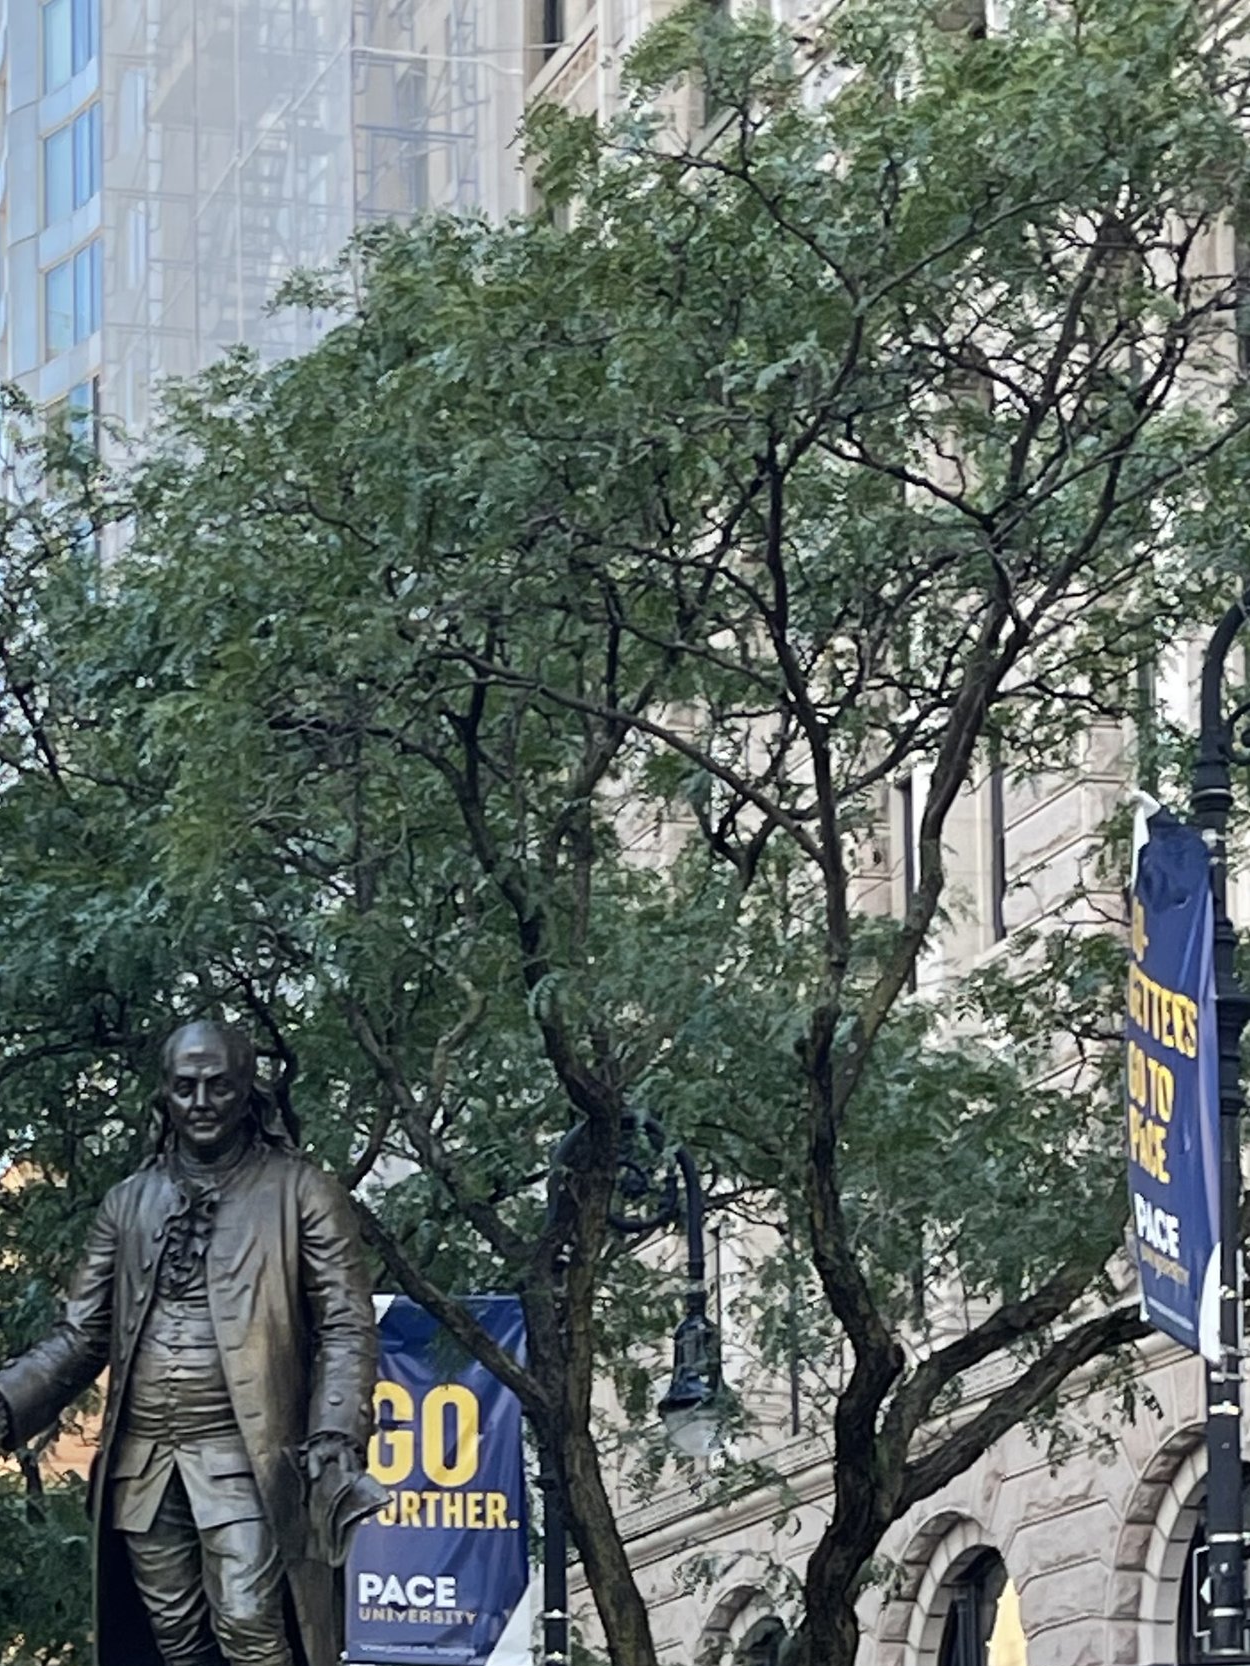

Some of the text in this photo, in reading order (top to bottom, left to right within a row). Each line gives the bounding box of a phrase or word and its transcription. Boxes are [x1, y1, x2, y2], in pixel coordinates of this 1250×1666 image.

[1147, 1057, 1174, 1123] TO
[1128, 1104, 1171, 1184] PACE
[1134, 1193, 1180, 1259] PACE
[366, 1380, 479, 1487] GO
[360, 1490, 520, 1529] URTHER.
[358, 1573, 457, 1608] PACE
[358, 1606, 477, 1626] UNIVERSITY
